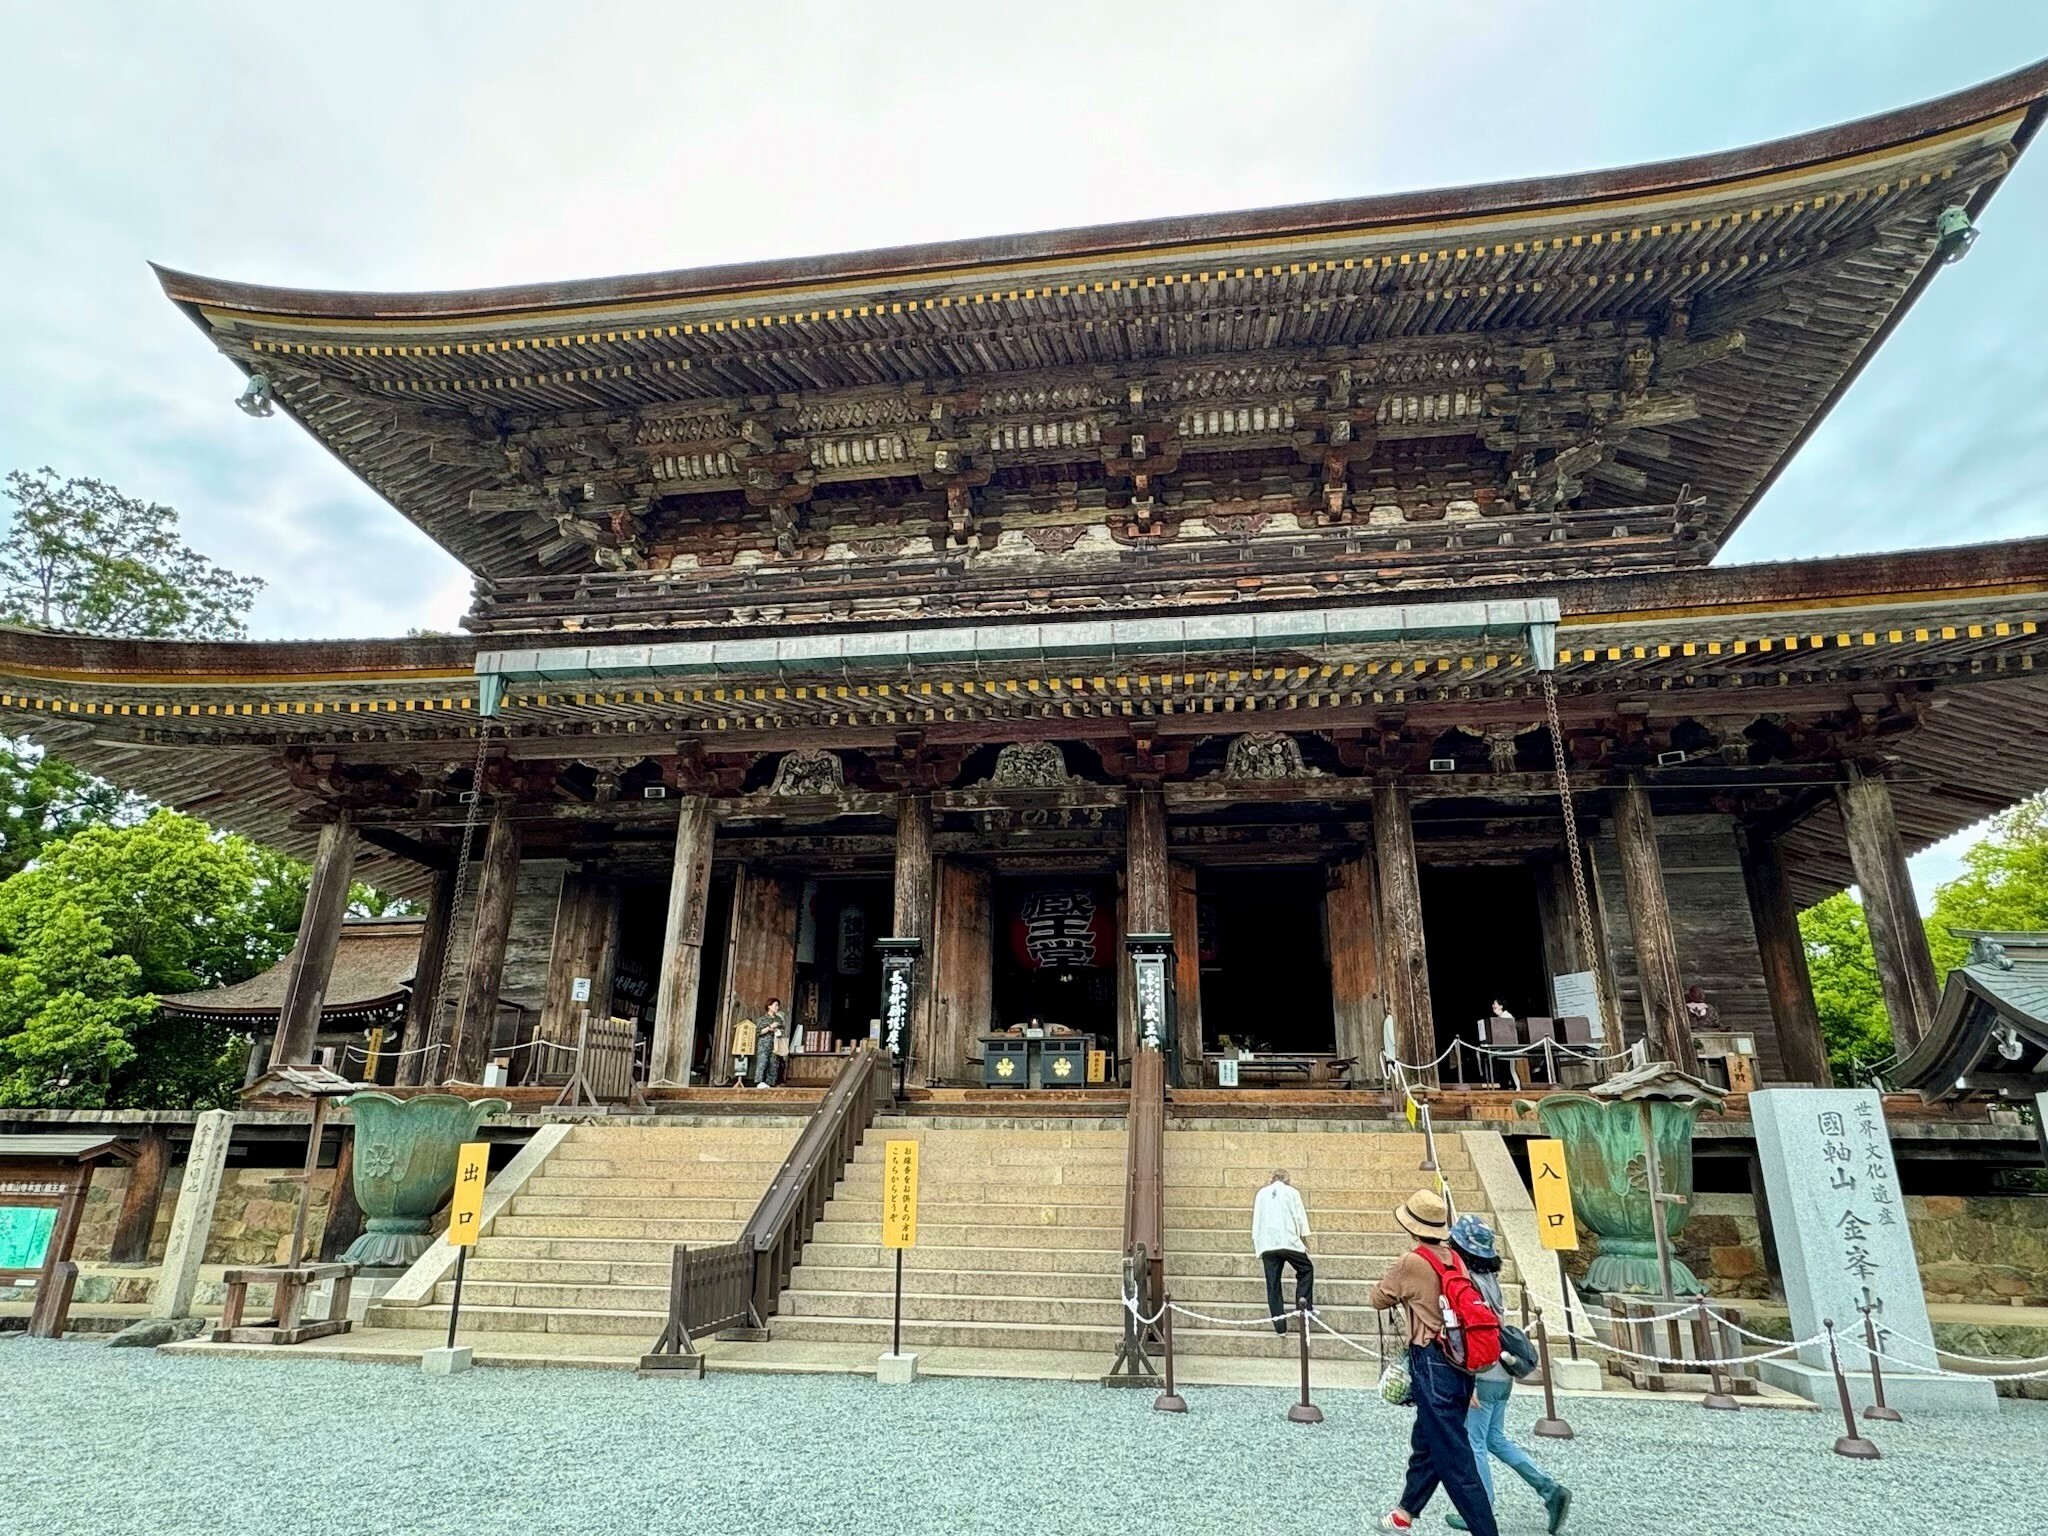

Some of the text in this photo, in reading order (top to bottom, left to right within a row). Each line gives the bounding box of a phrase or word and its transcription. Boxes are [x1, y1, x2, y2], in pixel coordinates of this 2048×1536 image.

[459, 1163, 479, 1226] 出口
[890, 1146, 899, 1223] こちらからどうぞ
[901, 1146, 912, 1242] お線香をお供えの方は
[1538, 1163, 1565, 1228] 入口
[1854, 1101, 1897, 1226] 世界文化遺産
